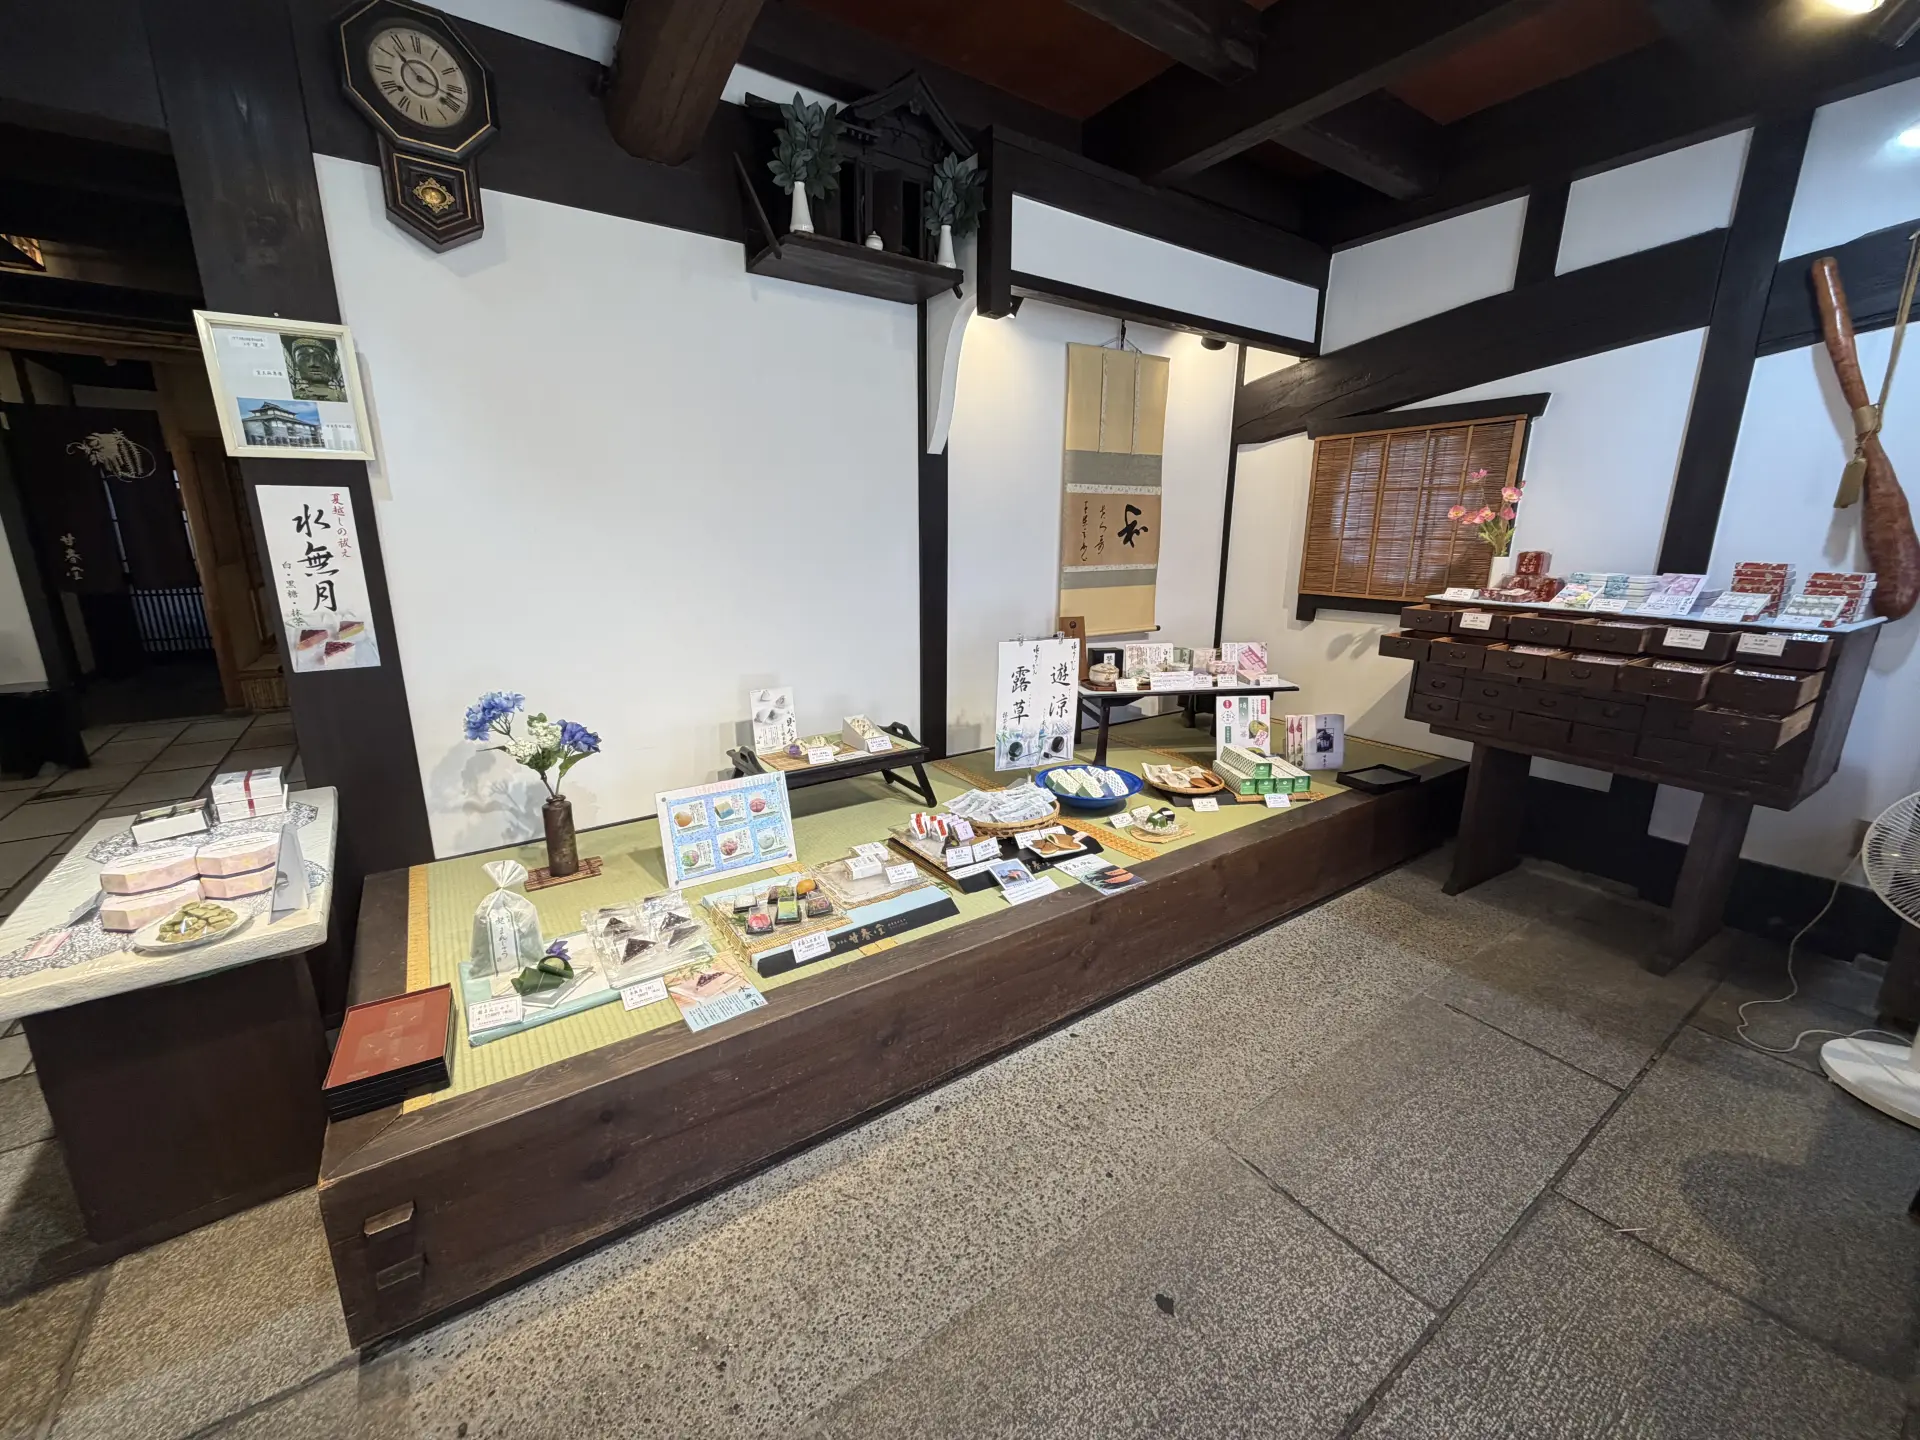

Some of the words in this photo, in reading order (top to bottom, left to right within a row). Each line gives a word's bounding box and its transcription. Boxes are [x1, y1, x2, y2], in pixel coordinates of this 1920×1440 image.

[329, 492, 352, 558] 夏越しの祓え
[59, 532, 85, 581] 甘春堂
[292, 504, 340, 612] 水無月
[1010, 666, 1032, 726] 露草
[1049, 663, 1071, 718] 遊涼
[848, 923, 886, 944] 甘春堂
